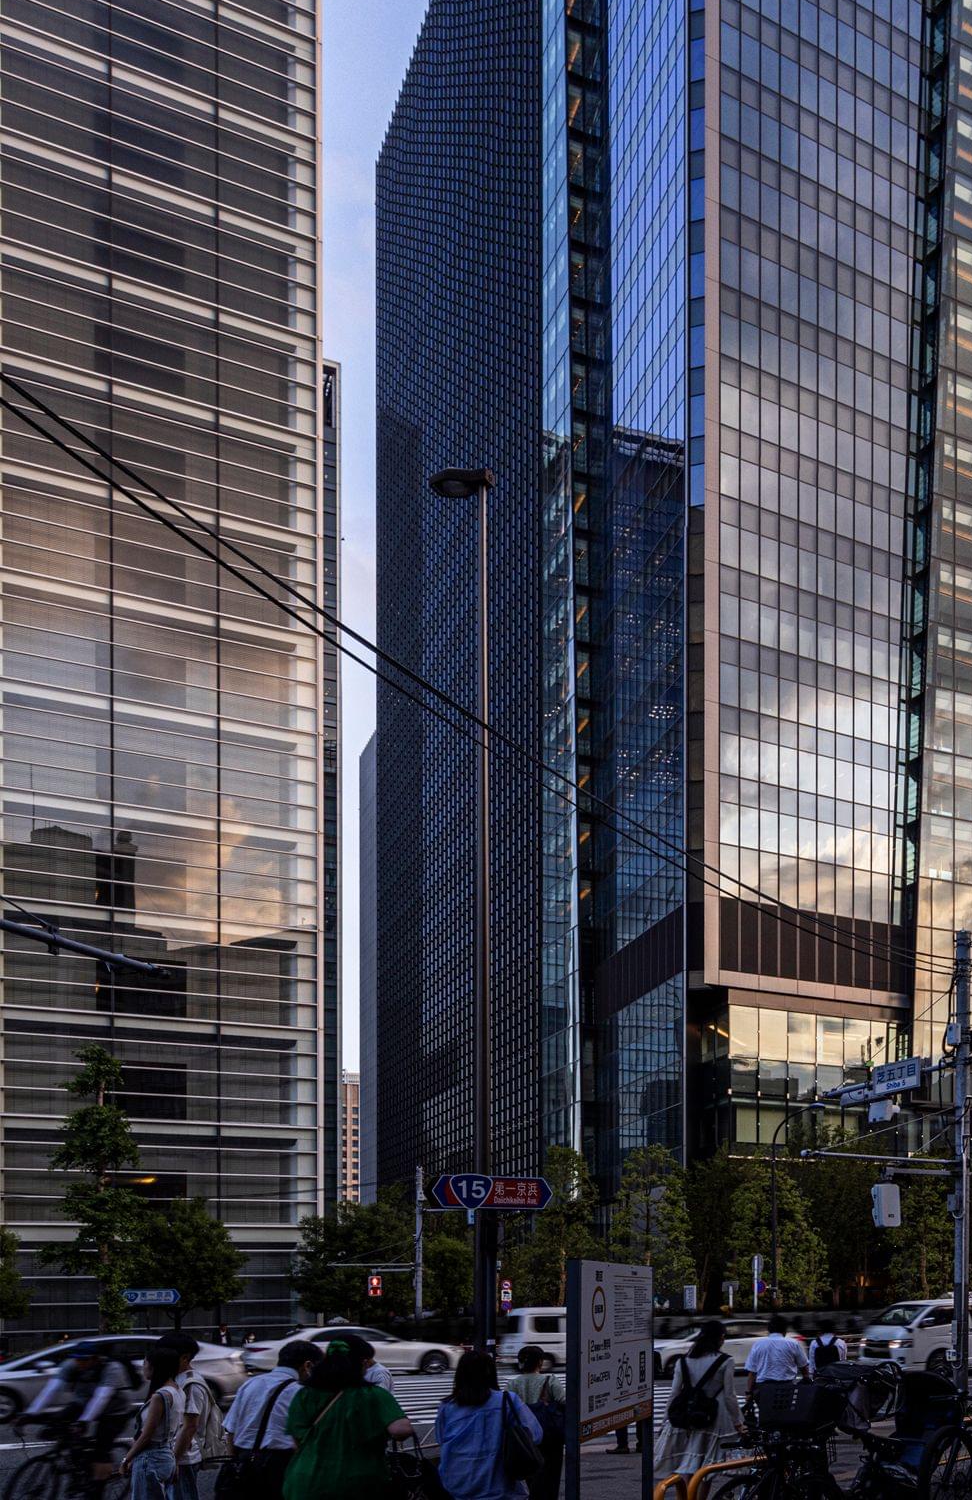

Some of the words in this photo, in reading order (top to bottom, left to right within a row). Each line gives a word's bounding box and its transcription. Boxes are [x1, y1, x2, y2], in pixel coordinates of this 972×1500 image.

[876, 1063, 916, 1085] 芝五丁目
[886, 1081, 901, 1090] Shiba
[457, 1180, 486, 1199] 15
[494, 1181, 538, 1196] 第一京浜
